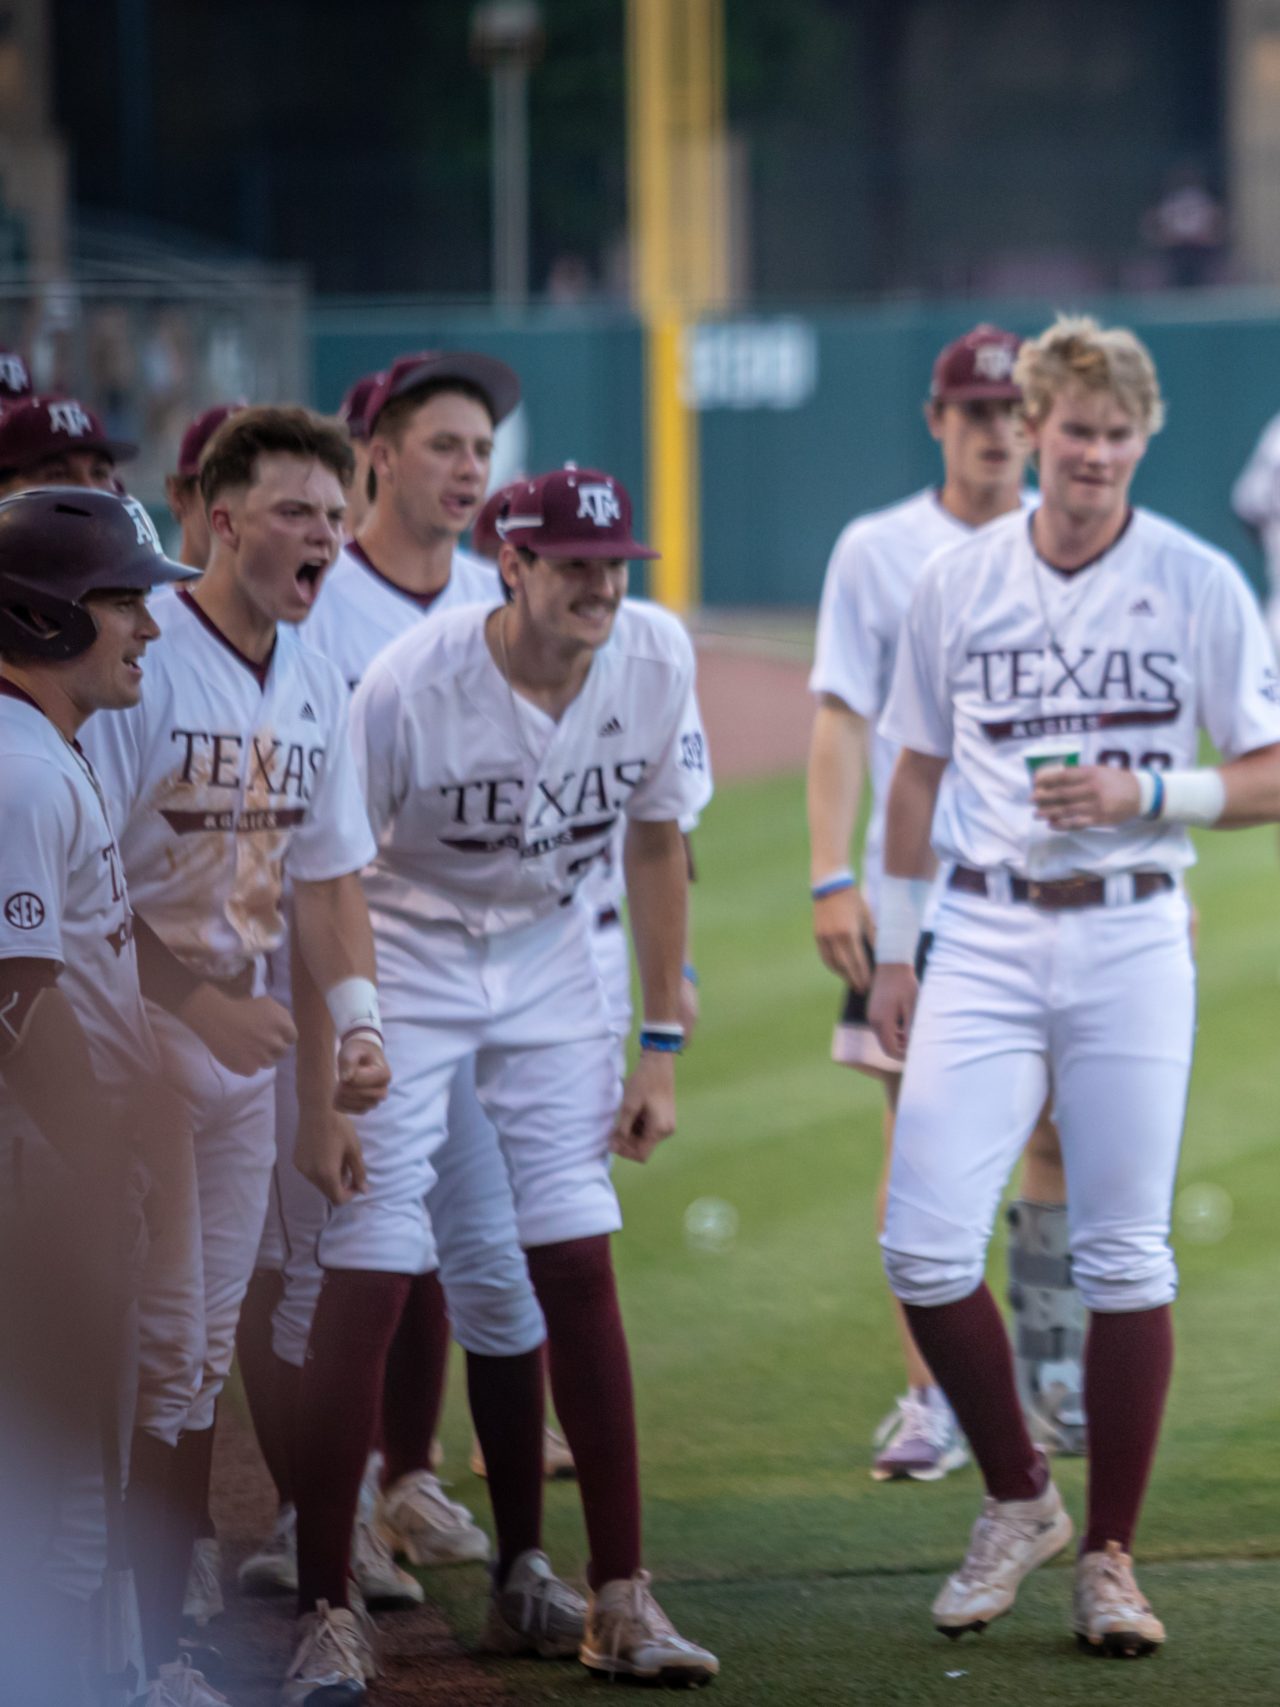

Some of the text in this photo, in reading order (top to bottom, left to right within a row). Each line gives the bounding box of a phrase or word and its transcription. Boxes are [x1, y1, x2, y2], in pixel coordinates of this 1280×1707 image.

[577, 484, 621, 527] ATM
[967, 643, 1178, 702] TEXAS
[1012, 713, 1100, 739] AGGIES
[6, 894, 43, 929] SEC
